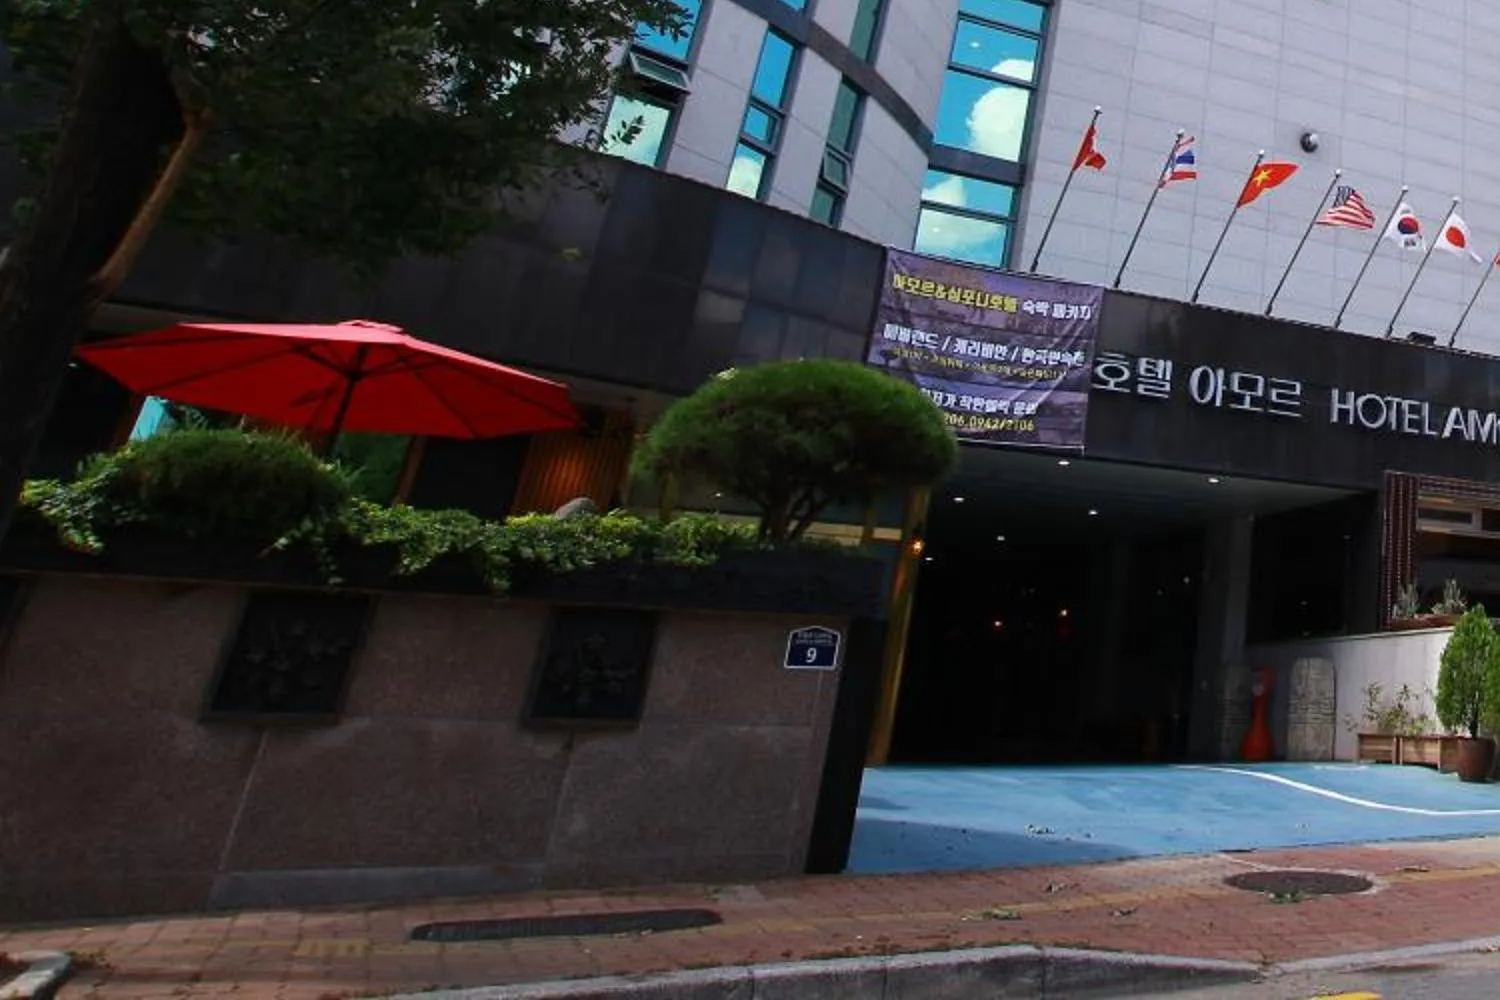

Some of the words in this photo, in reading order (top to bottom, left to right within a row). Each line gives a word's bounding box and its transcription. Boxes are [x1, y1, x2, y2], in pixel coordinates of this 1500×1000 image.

[1093, 352, 1172, 399] 호텔
[1190, 364, 1303, 419] 아모르
[1330, 387, 1436, 436] HOTEL
[805, 647, 817, 664] 9
